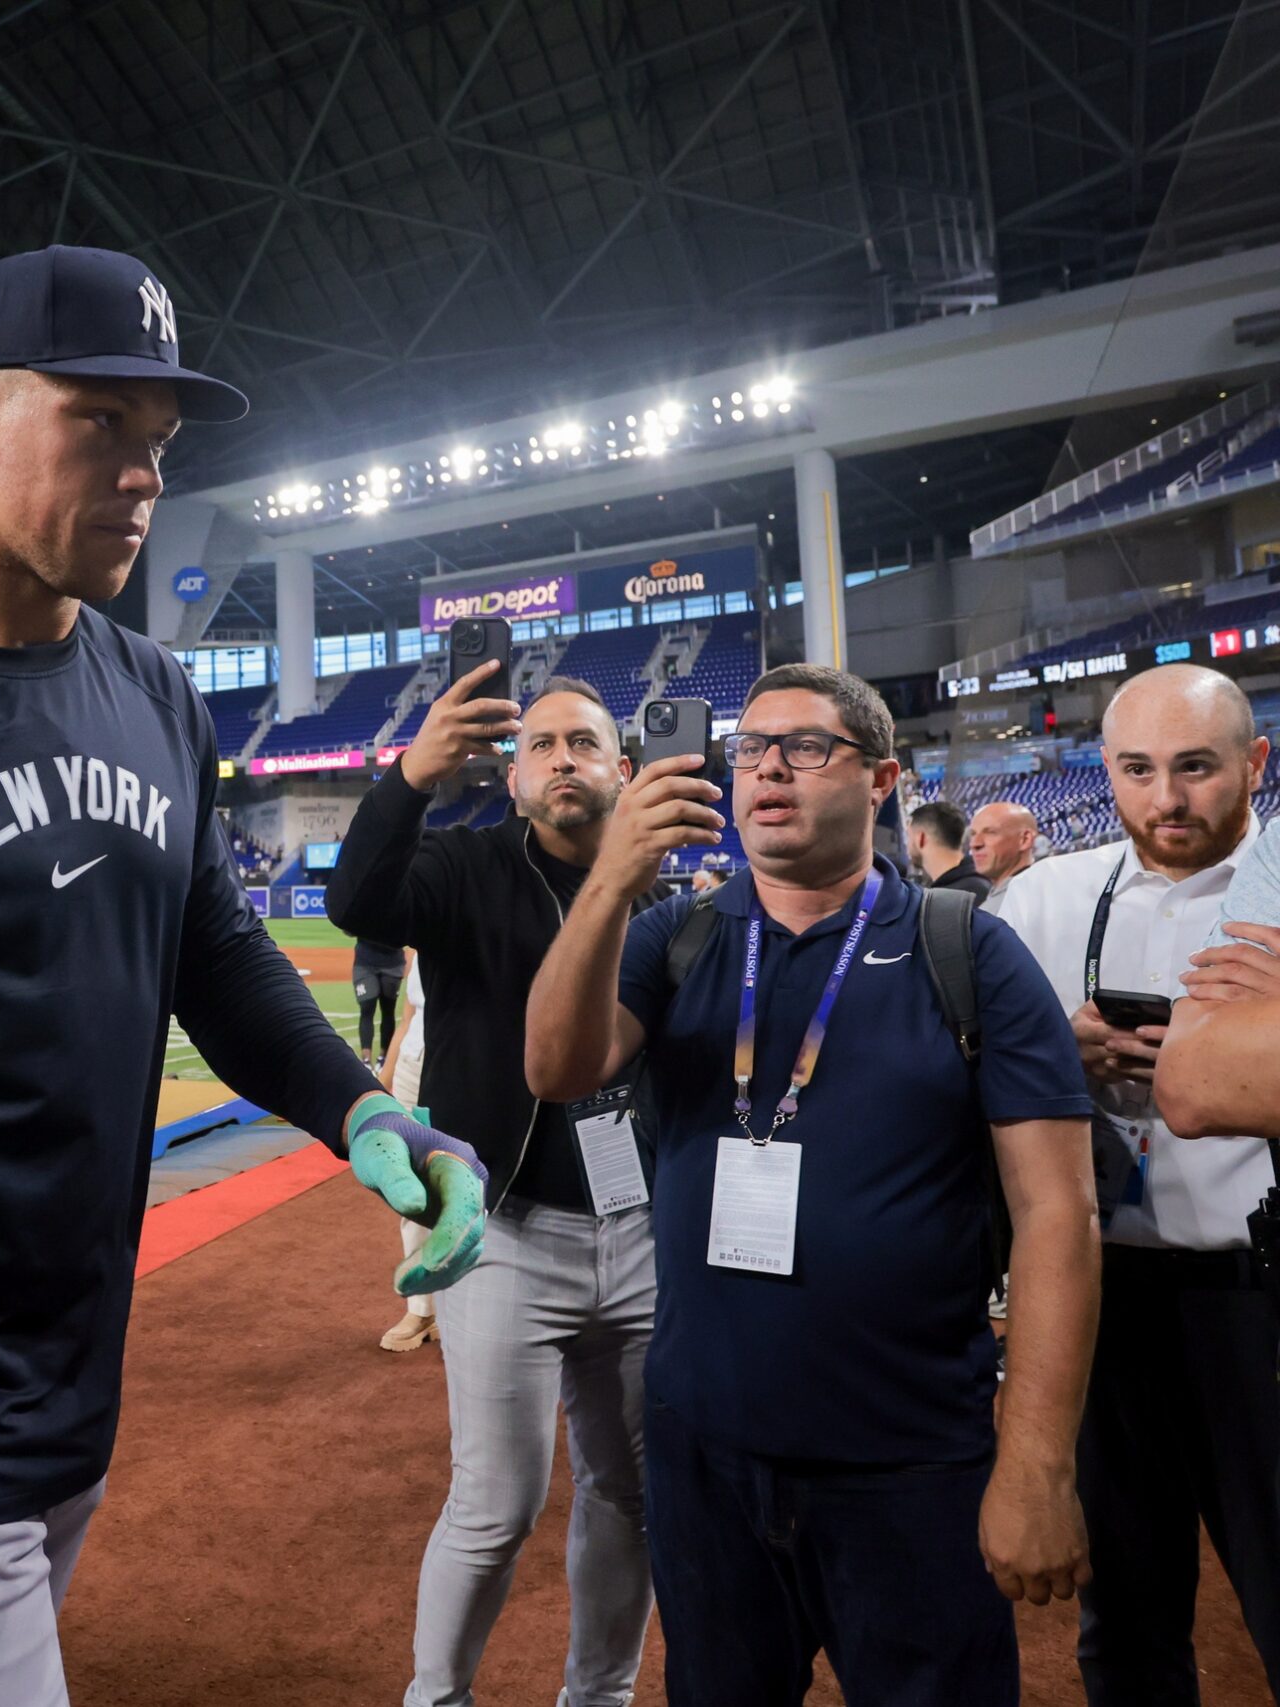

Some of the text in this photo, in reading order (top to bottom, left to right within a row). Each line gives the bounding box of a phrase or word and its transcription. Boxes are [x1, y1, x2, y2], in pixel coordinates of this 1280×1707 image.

[177, 576, 205, 591] ADT
[434, 580, 560, 621] loanDepot
[624, 573, 704, 604] Corona
[1086, 653, 1127, 676] RAFFLE
[277, 754, 349, 771] Multinational
[53, 755, 172, 851] YORK
[746, 920, 760, 978] POSTSEASON
[834, 919, 865, 976] POSTSEASON
